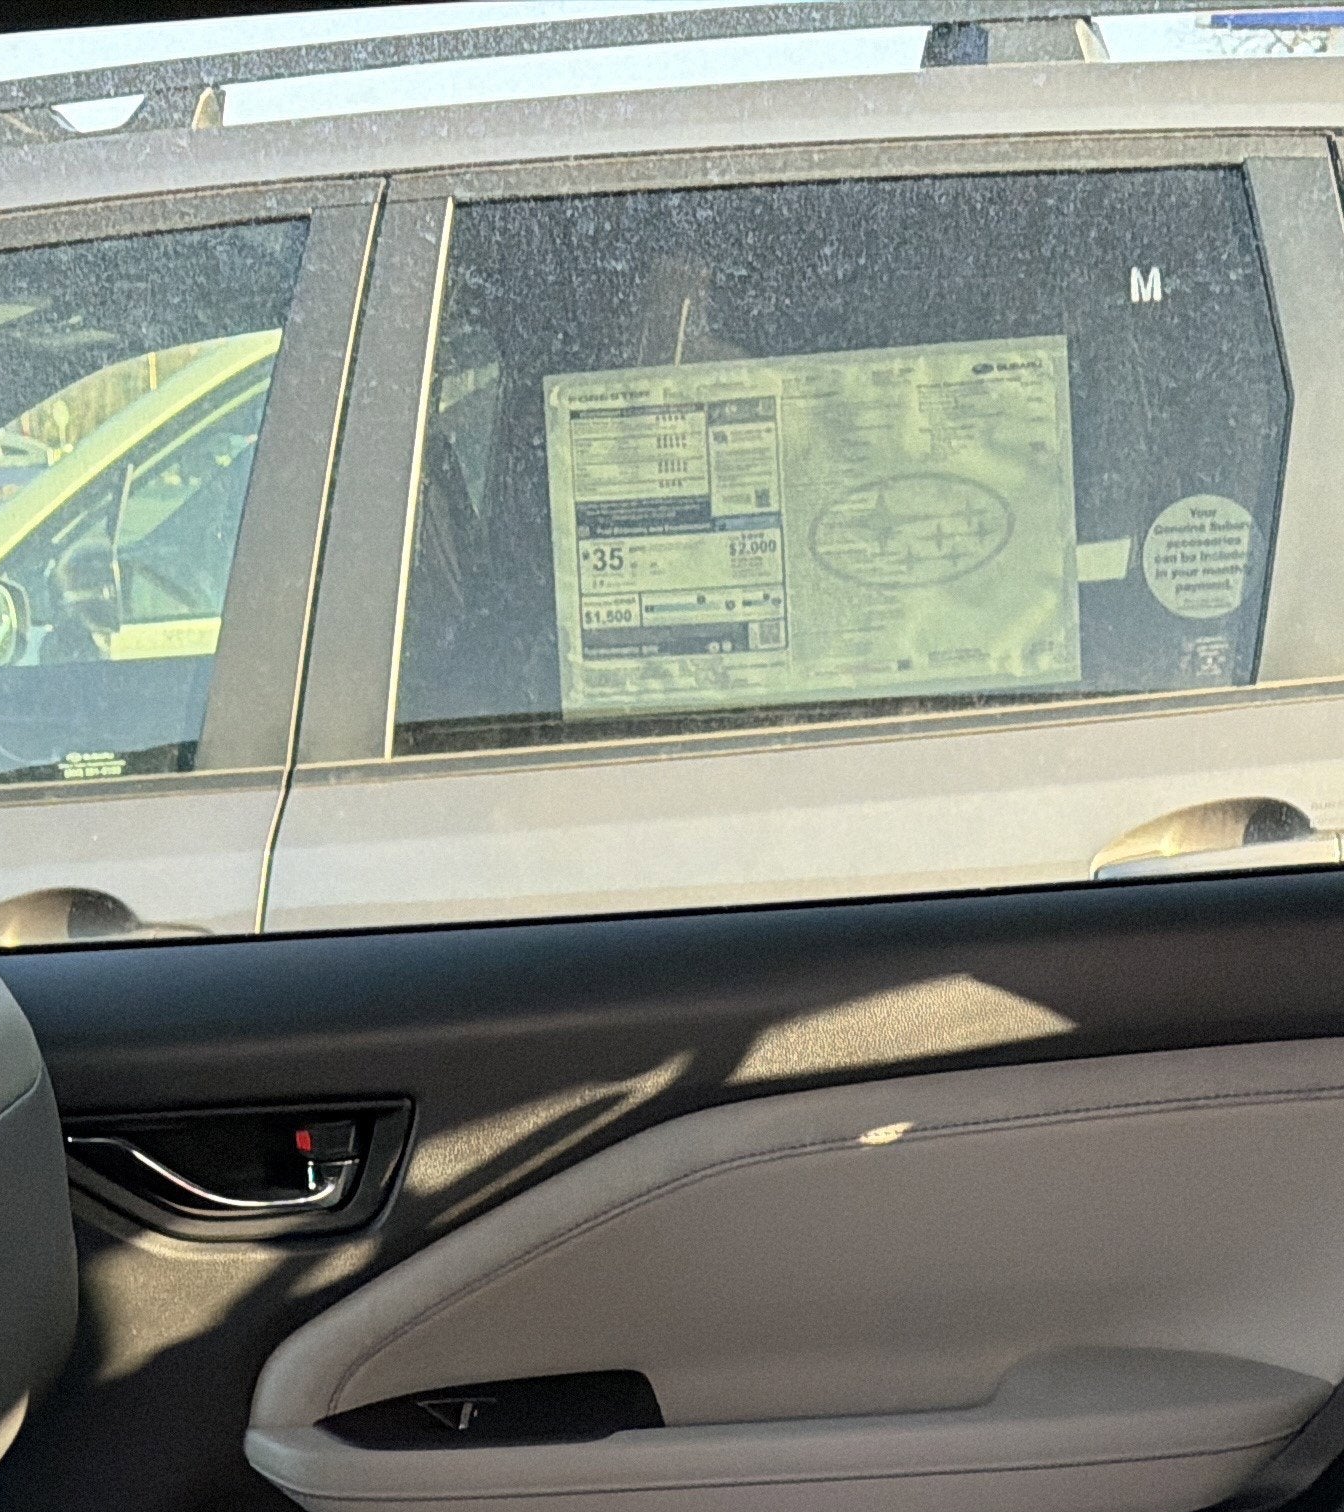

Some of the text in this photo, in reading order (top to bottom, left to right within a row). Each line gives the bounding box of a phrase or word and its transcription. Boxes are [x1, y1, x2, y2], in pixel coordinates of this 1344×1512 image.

[1130, 266, 1163, 303] M
[567, 389, 651, 404] FORESTER
[592, 546, 625, 572] 35
[584, 608, 633, 625] $1,500
